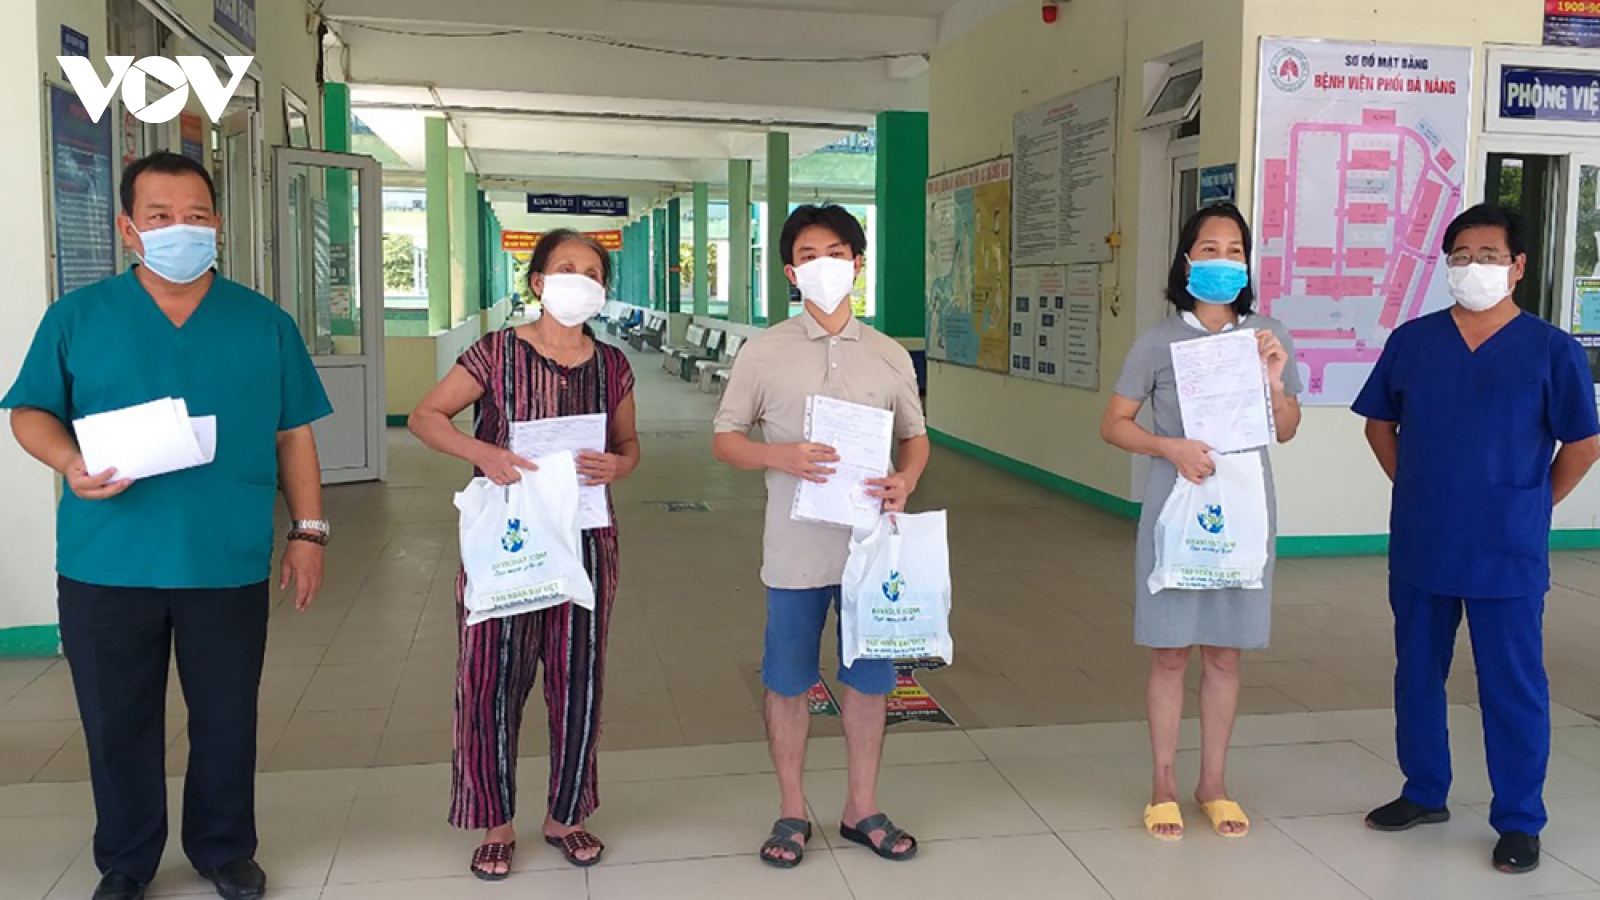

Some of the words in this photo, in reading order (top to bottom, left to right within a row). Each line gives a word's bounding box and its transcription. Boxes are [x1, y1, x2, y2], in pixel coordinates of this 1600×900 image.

[1314, 71, 1344, 91] BỆNH
[1349, 73, 1374, 93] VIỆN
[1507, 76, 1567, 110] PHÒNG
